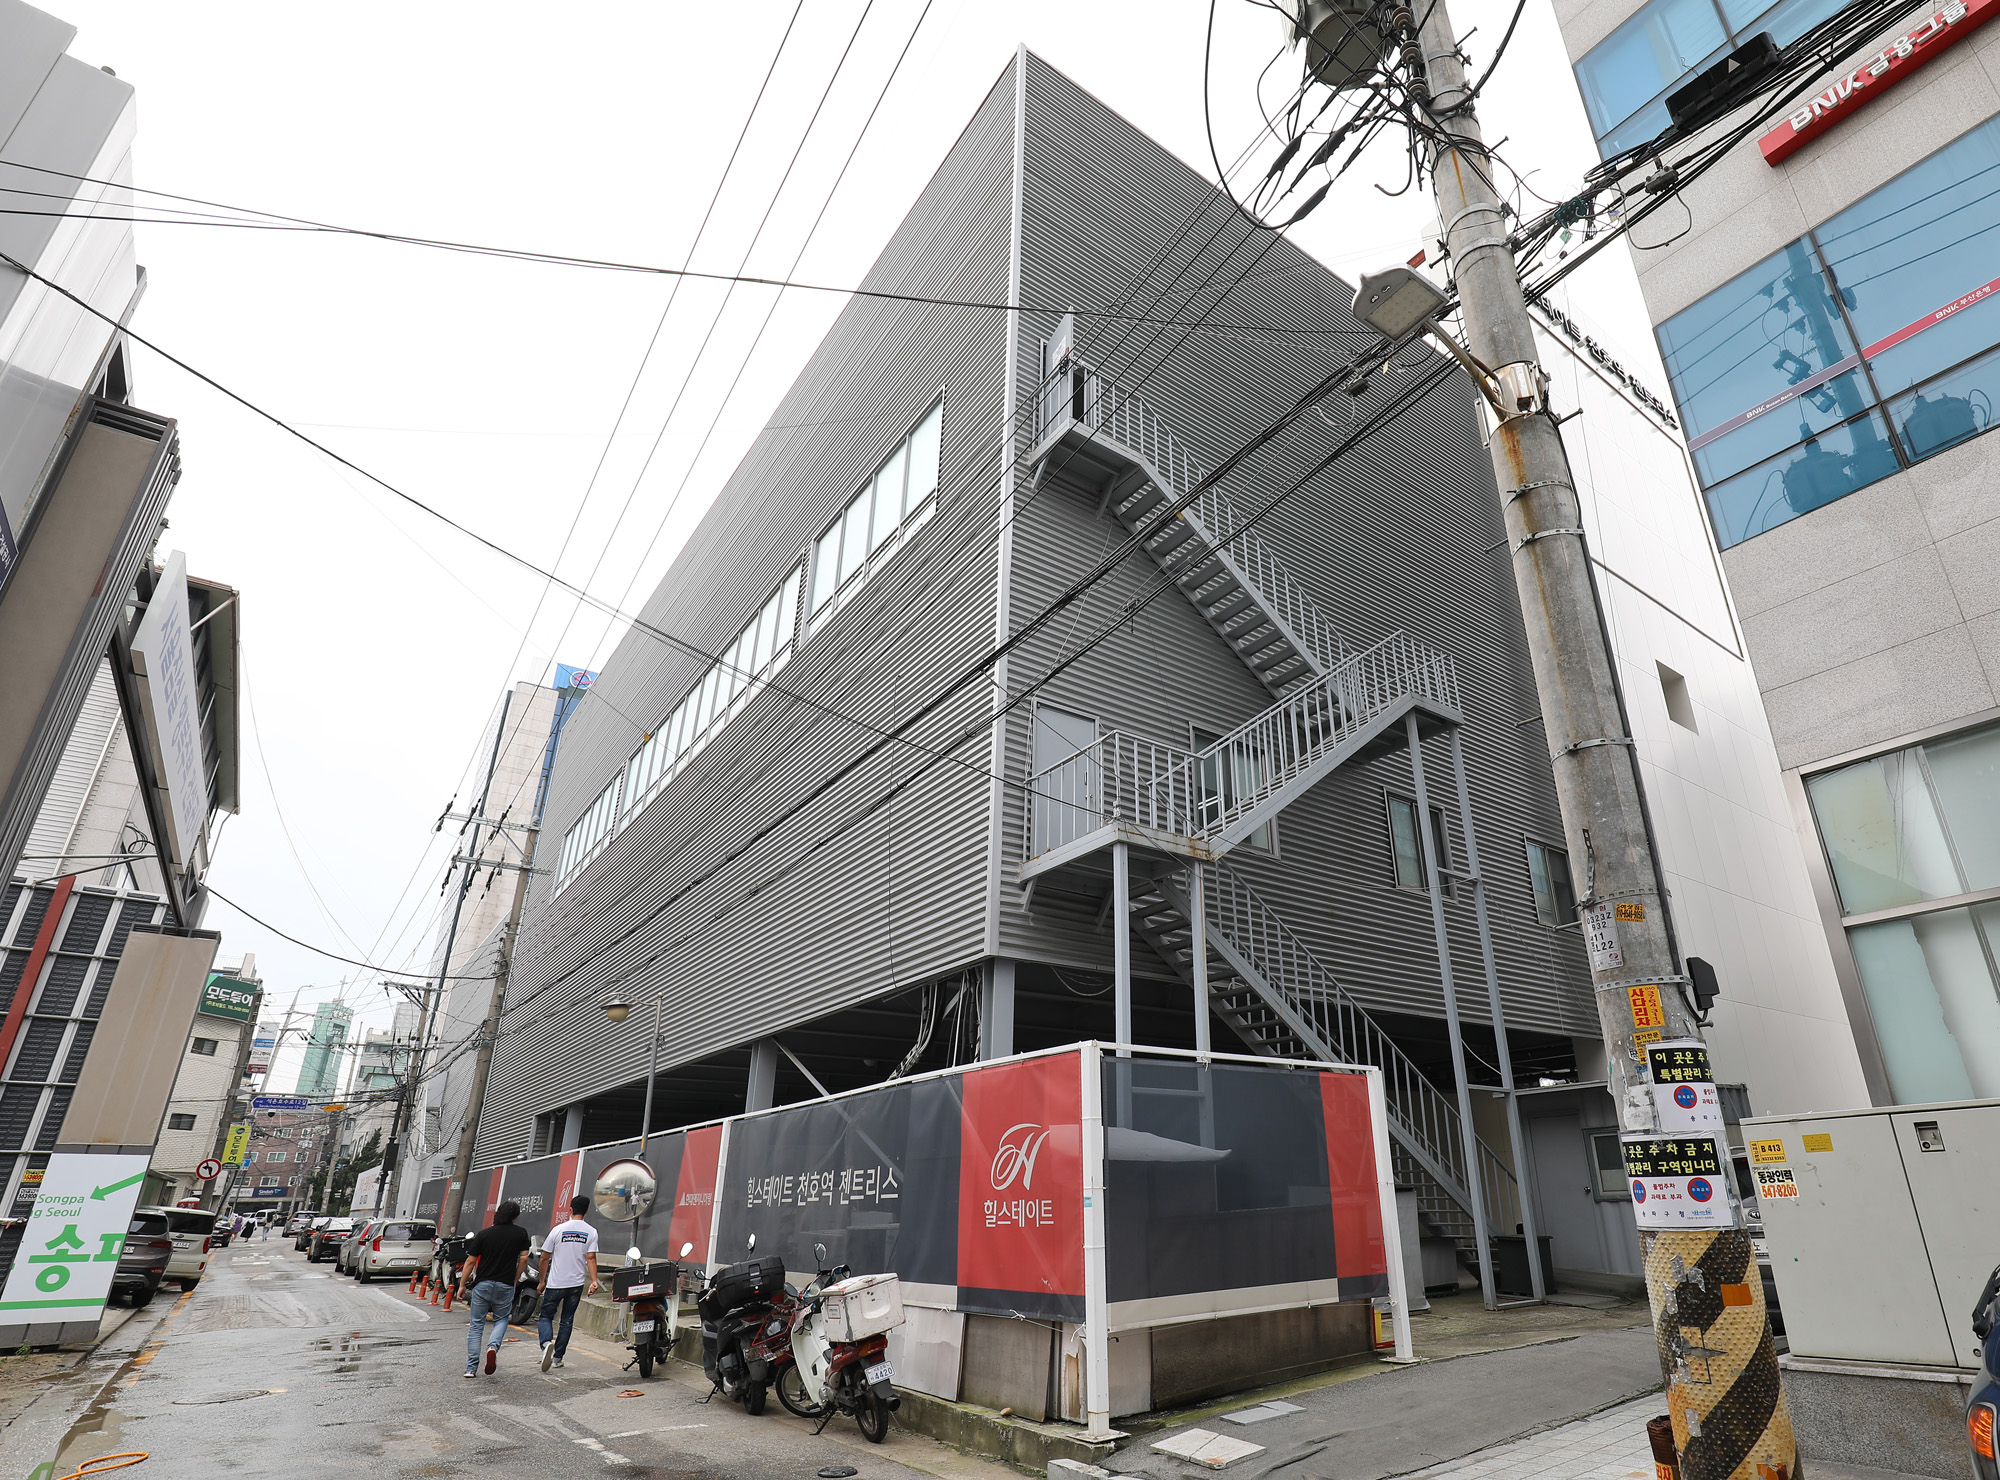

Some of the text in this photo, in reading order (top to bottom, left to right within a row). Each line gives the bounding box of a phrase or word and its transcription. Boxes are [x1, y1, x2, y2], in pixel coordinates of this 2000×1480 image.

[1789, 71, 1865, 133] BNK
[1935, 285, 1991, 319] BNK 부산은행
[1746, 405, 1766, 419] BNK
[206, 985, 253, 1007] 모두투어
[1655, 1052, 1667, 1063] 이
[1673, 1051, 1694, 1064] 곳은
[1660, 1068, 1702, 1081] 특별관리
[1629, 1145, 1644, 1158] 곳은
[1768, 1144, 1781, 1152] 413
[1657, 1159, 1715, 1174] 구역입니다
[1757, 1169, 1794, 1184] 동광인력
[746, 1165, 899, 1208] 힐스테이트 천호역 젠트리스
[36, 1193, 85, 1205] Songpa
[45, 1207, 82, 1217] Seoul
[983, 1198, 1055, 1228] 힐스테이트
